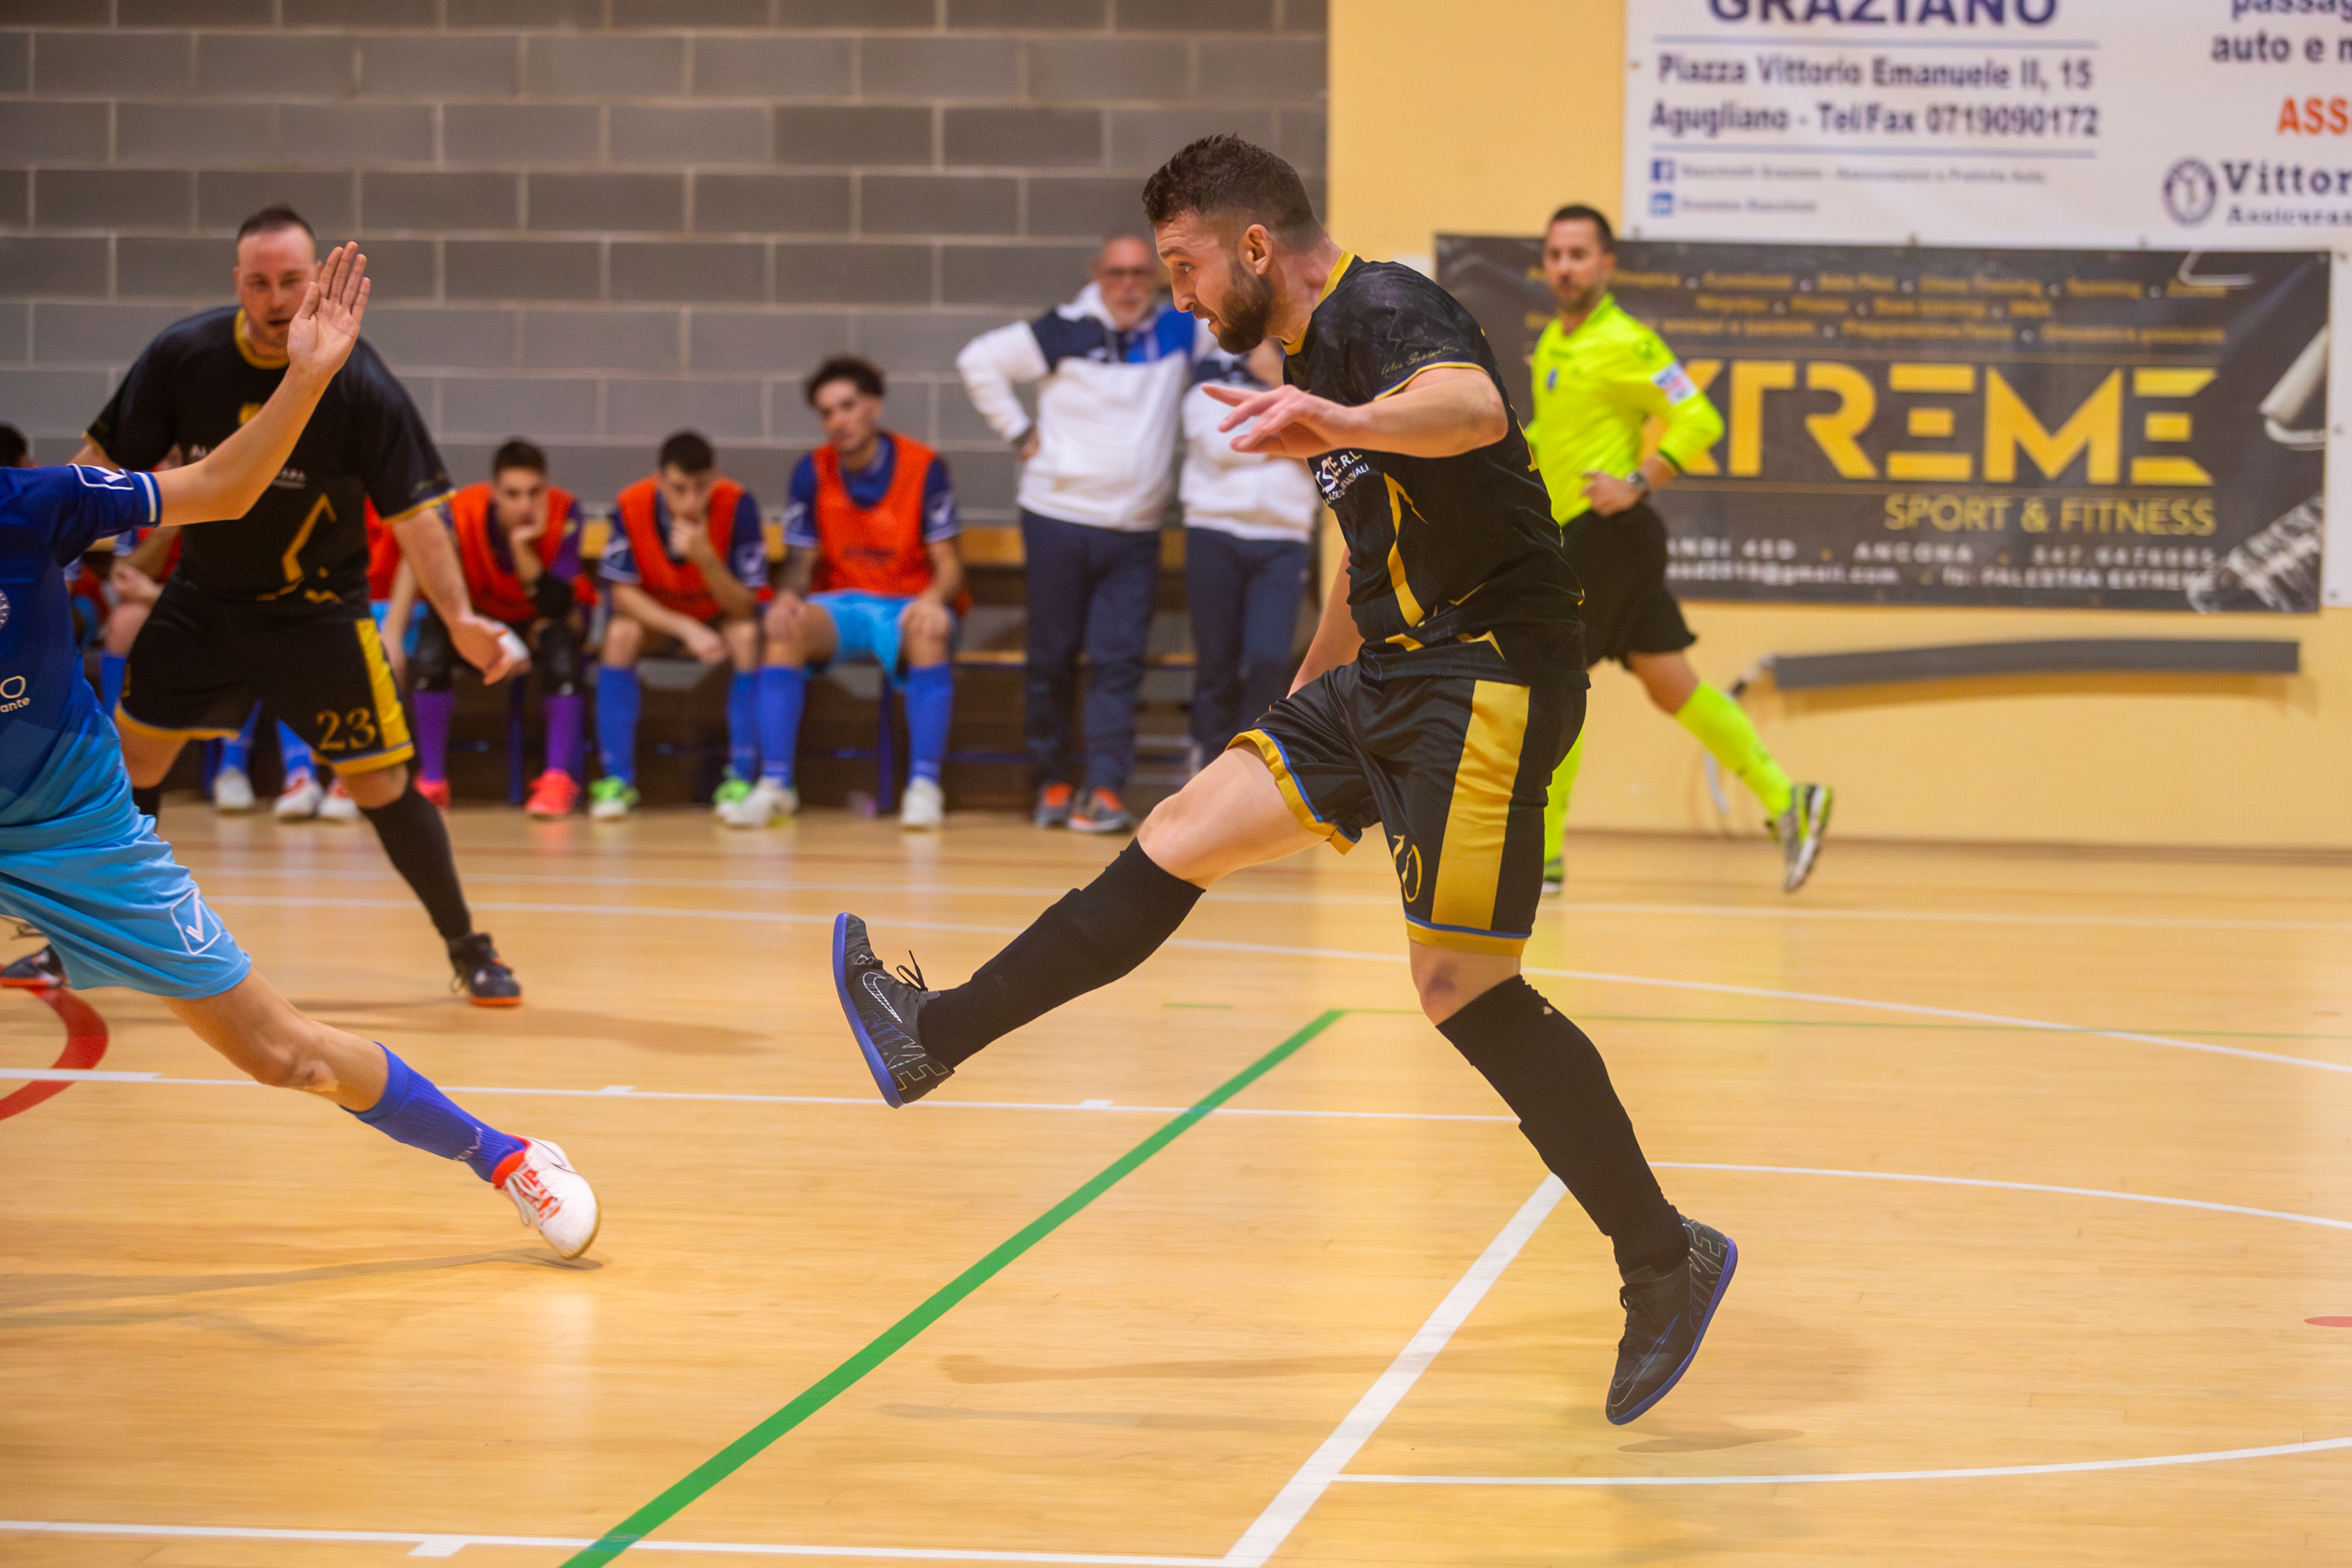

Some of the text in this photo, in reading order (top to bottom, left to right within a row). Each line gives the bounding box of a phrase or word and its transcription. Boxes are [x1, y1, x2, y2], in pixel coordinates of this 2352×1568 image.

[2212, 30, 2290, 62] auto
[1659, 53, 1746, 84] Piazza
[1756, 54, 1861, 85] Vittorio
[1872, 57, 2010, 87] Emanuele
[2062, 58, 2092, 88] 15
[1652, 102, 1788, 137] Agugliano
[1884, 492, 2215, 536] SPORT & FITNESS
[1853, 540, 1973, 564] ANCONA
[315, 706, 376, 750] 23
